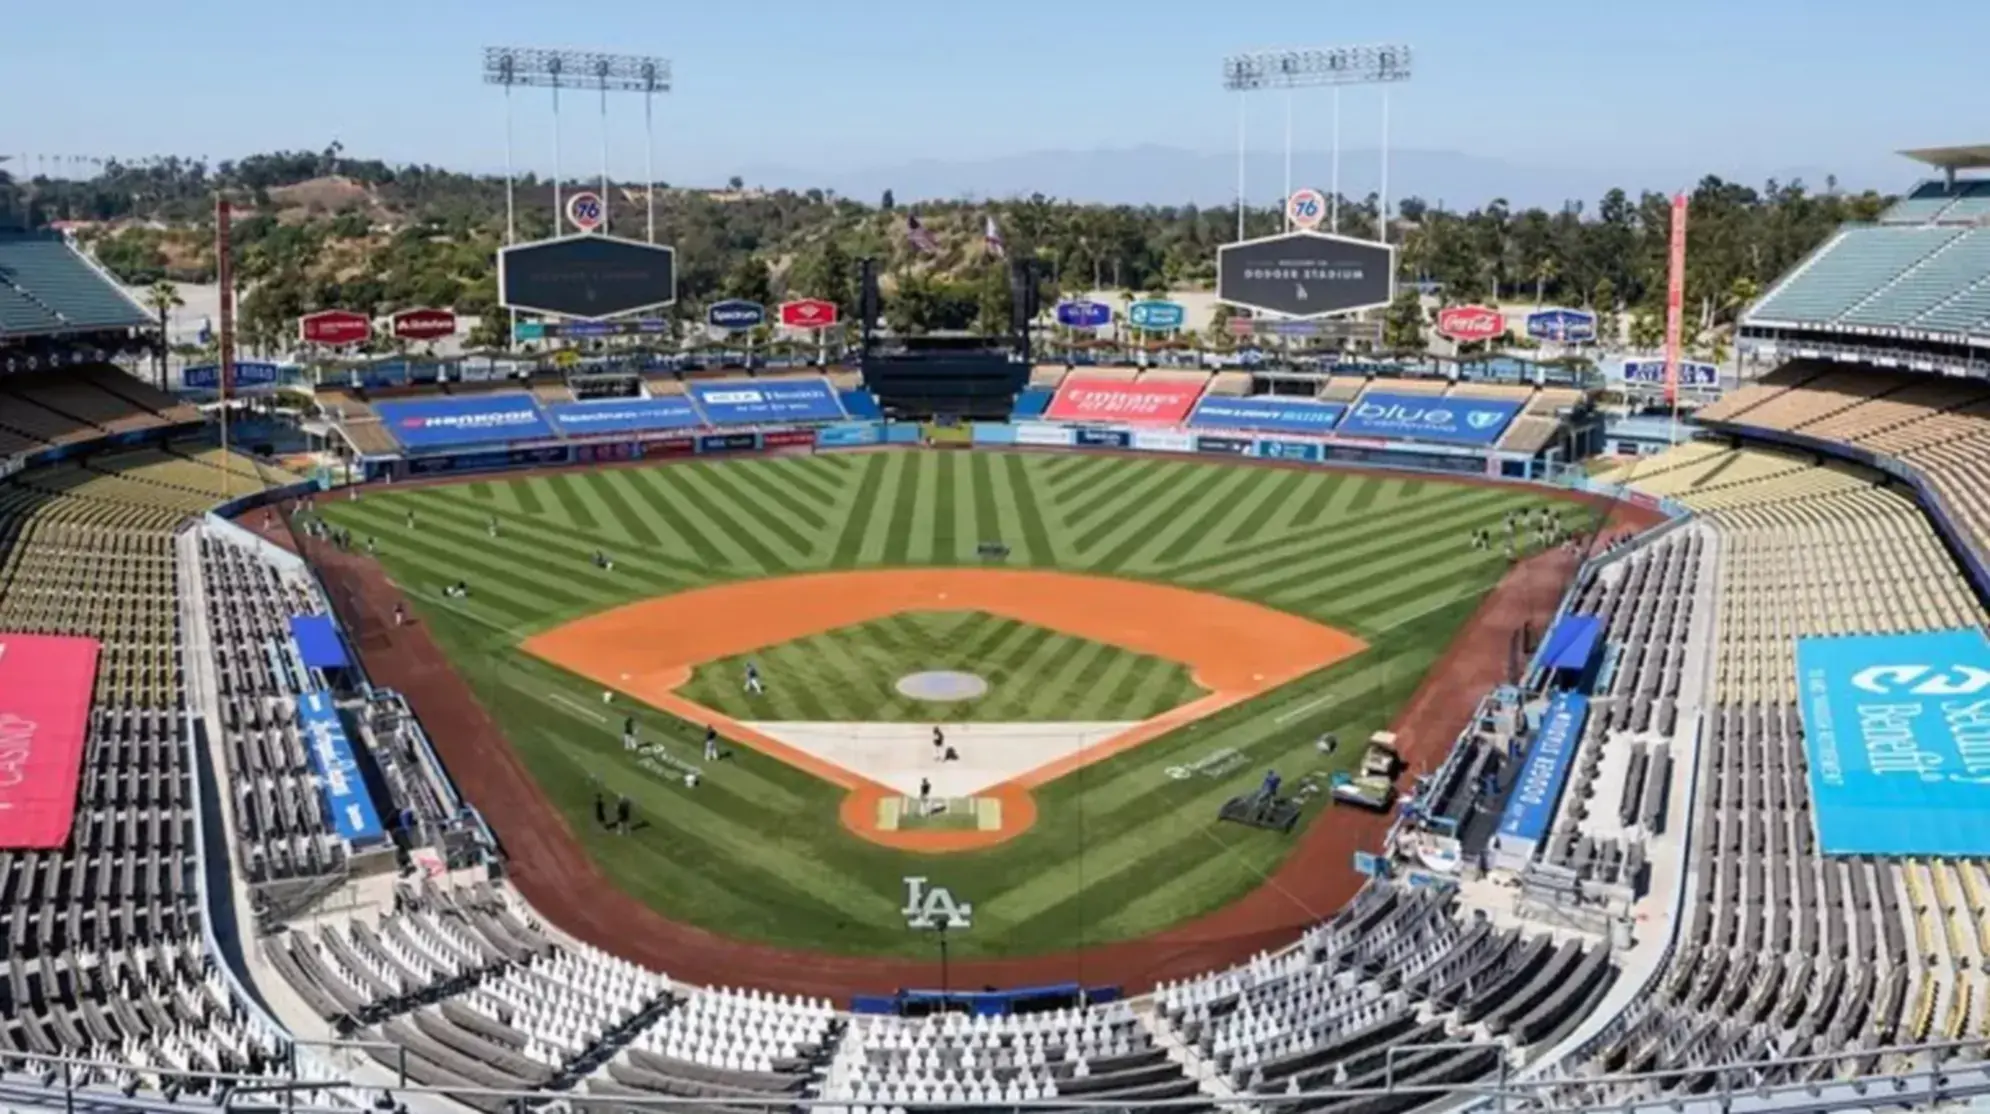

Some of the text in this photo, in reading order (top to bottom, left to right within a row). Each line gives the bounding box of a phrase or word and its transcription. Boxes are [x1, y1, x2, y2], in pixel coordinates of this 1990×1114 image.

[577, 203, 599, 218] 76
[1295, 199, 1318, 217] 76
[1244, 269, 1364, 280] DODGER STADIUM
[1355, 401, 1453, 424] blue
[901, 876, 971, 928] LA
